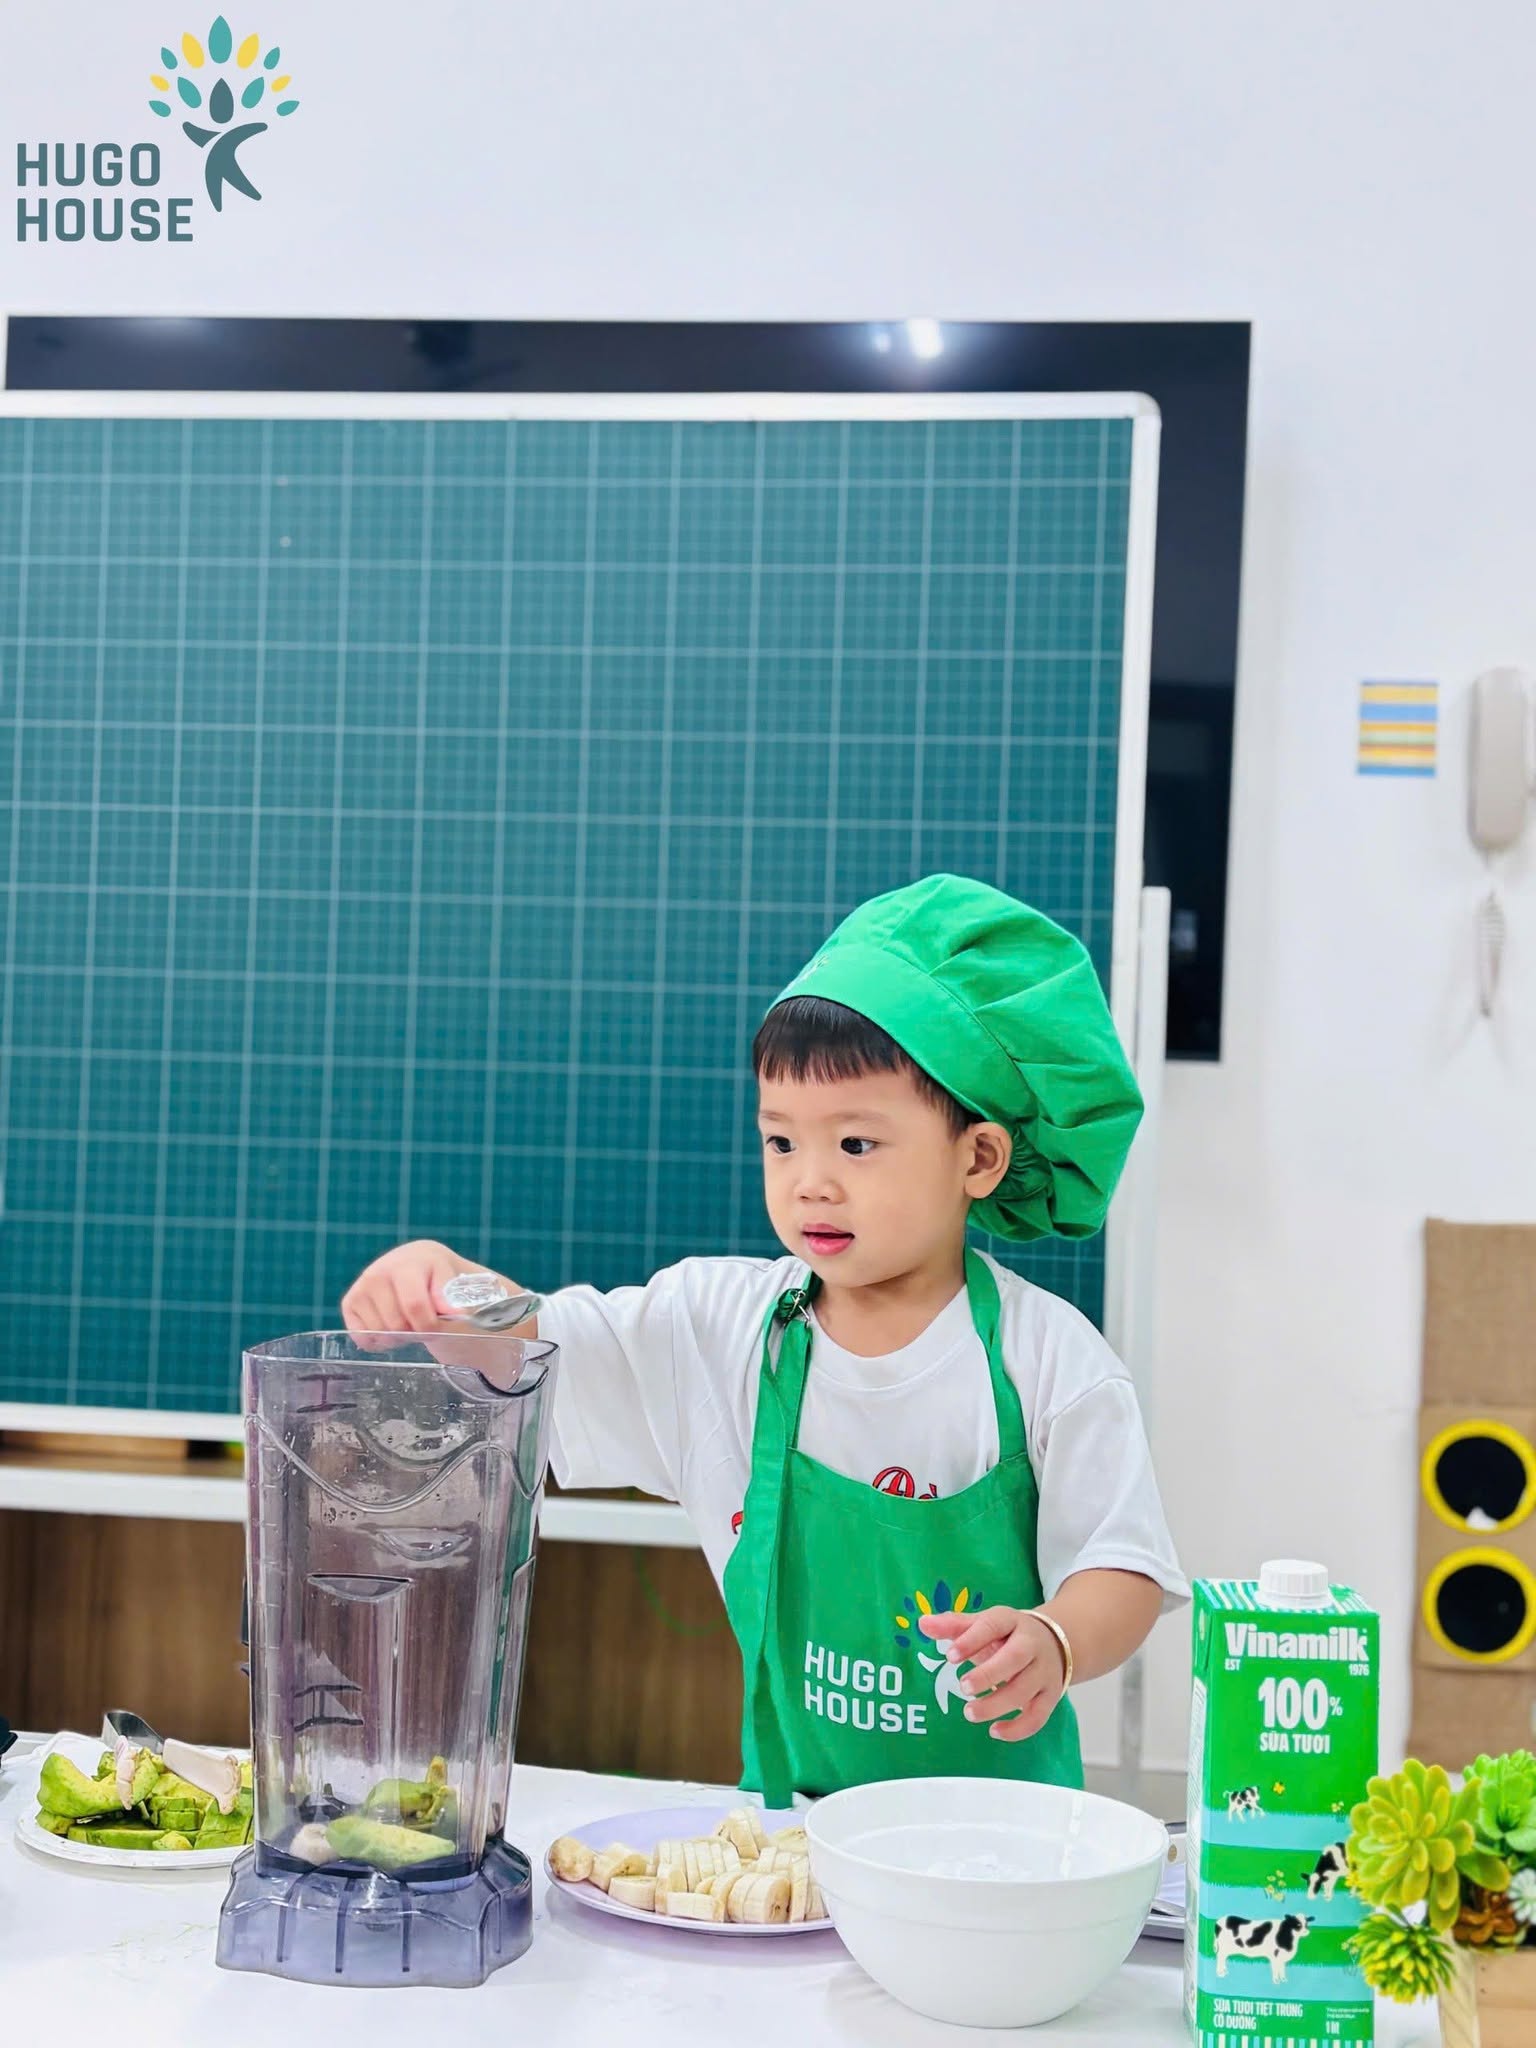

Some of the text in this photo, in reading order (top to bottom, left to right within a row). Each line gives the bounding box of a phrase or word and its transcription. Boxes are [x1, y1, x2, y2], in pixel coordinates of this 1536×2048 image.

[1224, 1622, 1370, 1661] Vinamilk
[804, 1640, 903, 1697] HUGO
[1224, 1658, 1241, 1671] EST
[1348, 1663, 1370, 1676] 1976
[804, 1679, 928, 1735] HOUSE
